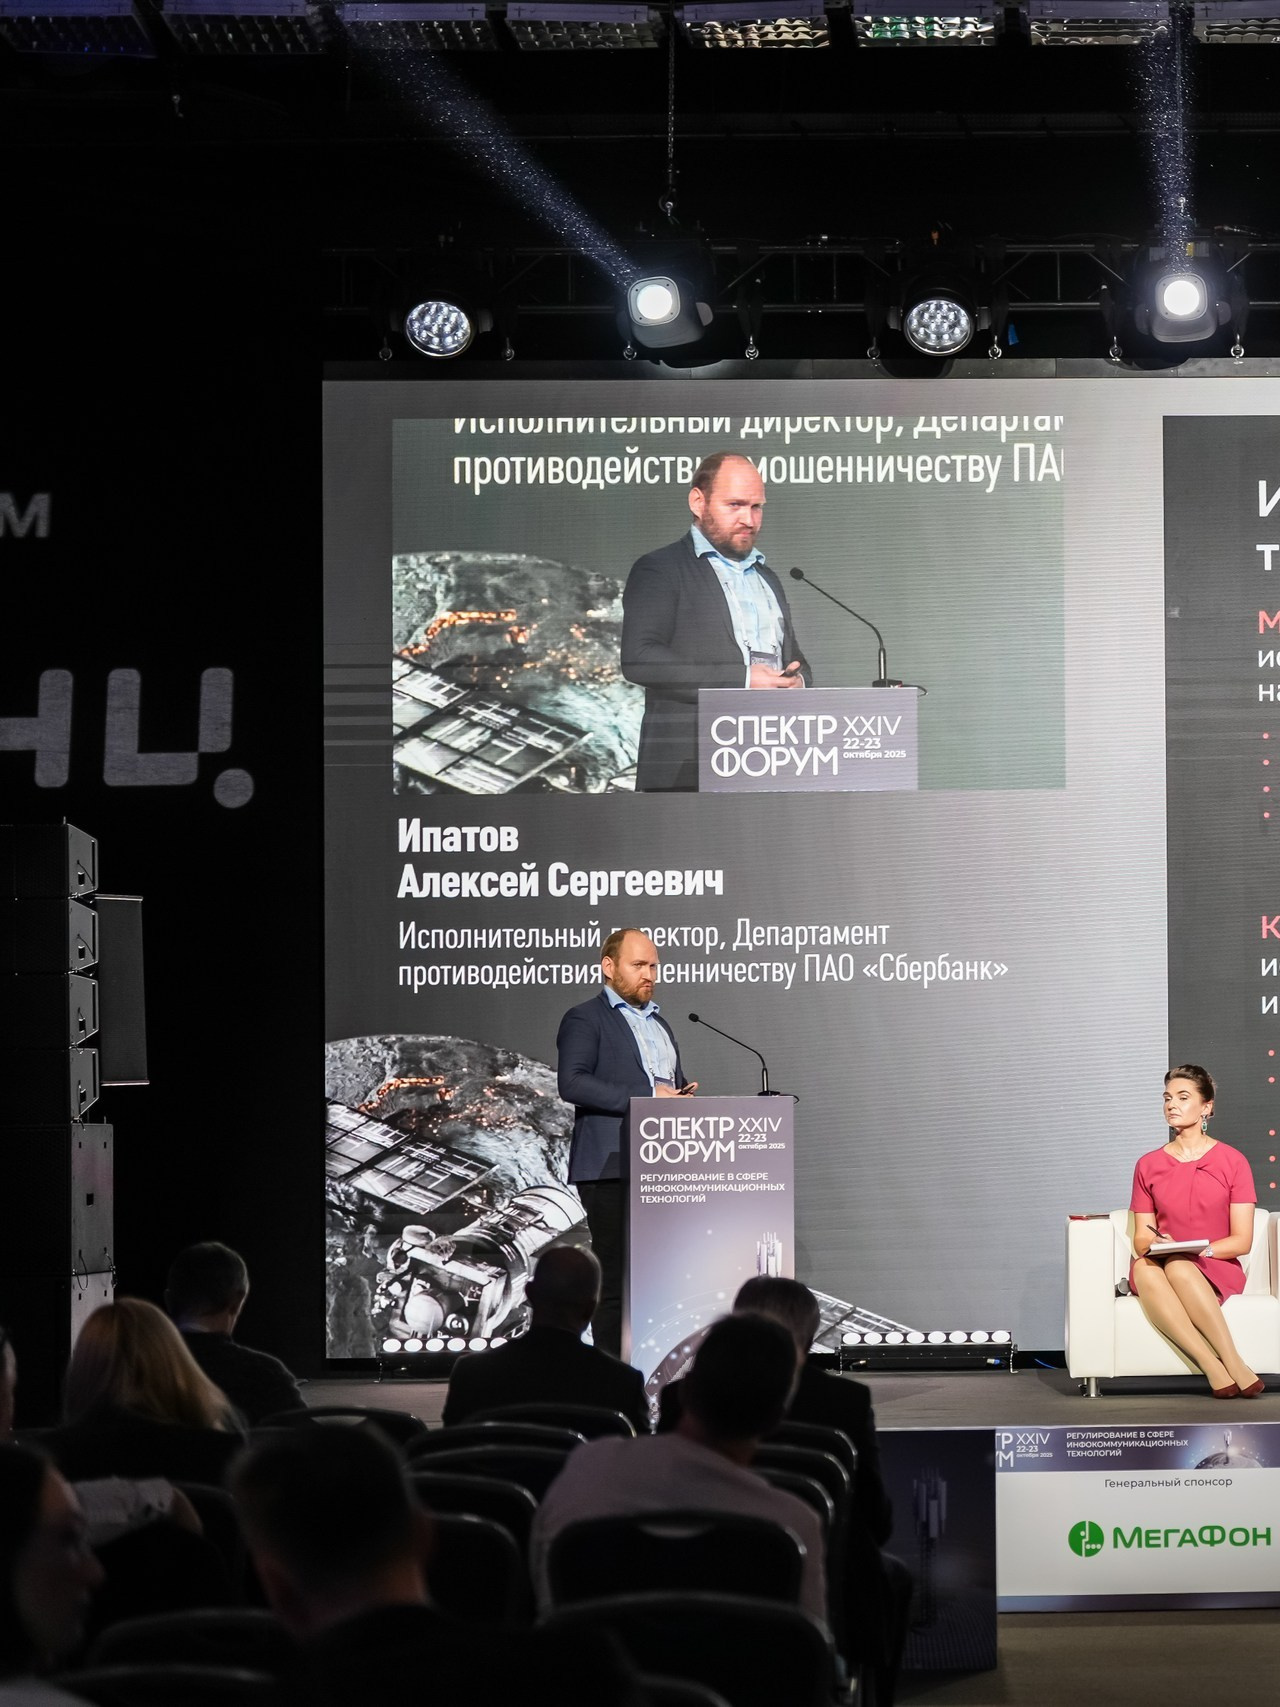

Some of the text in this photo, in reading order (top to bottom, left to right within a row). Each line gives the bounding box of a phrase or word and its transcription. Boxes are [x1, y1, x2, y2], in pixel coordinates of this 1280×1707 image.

[1014, 443, 1063, 481] ПА
[711, 715, 838, 746] СПЕКТР
[843, 716, 902, 735] XXIV
[843, 738, 881, 750] 22-23
[711, 747, 838, 777] ФОРУМ
[843, 750, 906, 760] октября 2025
[399, 818, 518, 852] Ипатов
[397, 862, 723, 905] Алексей Сергеевич
[400, 921, 600, 949] Исполнительный
[733, 919, 890, 952] Департамент
[399, 953, 601, 986] противодействия
[805, 955, 854, 982] ПАО
[863, 952, 1008, 981] «Сбербанк»
[639, 1117, 734, 1140] СПЕКТР
[738, 1117, 782, 1132] XXIV
[738, 1134, 766, 1142] 22-23
[639, 1140, 735, 1164] ФОРУМ
[641, 1173, 725, 1181] РЕГУЛИРОВАНИЕ
[641, 1184, 785, 1193] ИНФОКОММУНИКАЦИОННЫХ
[641, 1194, 706, 1203] ТЕХНОЛОГИЙ
[1016, 1433, 1050, 1444] XXIV
[1066, 1439, 1189, 1448] ИНФОКОММУНИКАЦИОННЫХ
[1067, 1449, 1121, 1457] ТЕХНОЛОГИЙ
[1105, 1478, 1232, 1489] Генеральный спонсор
